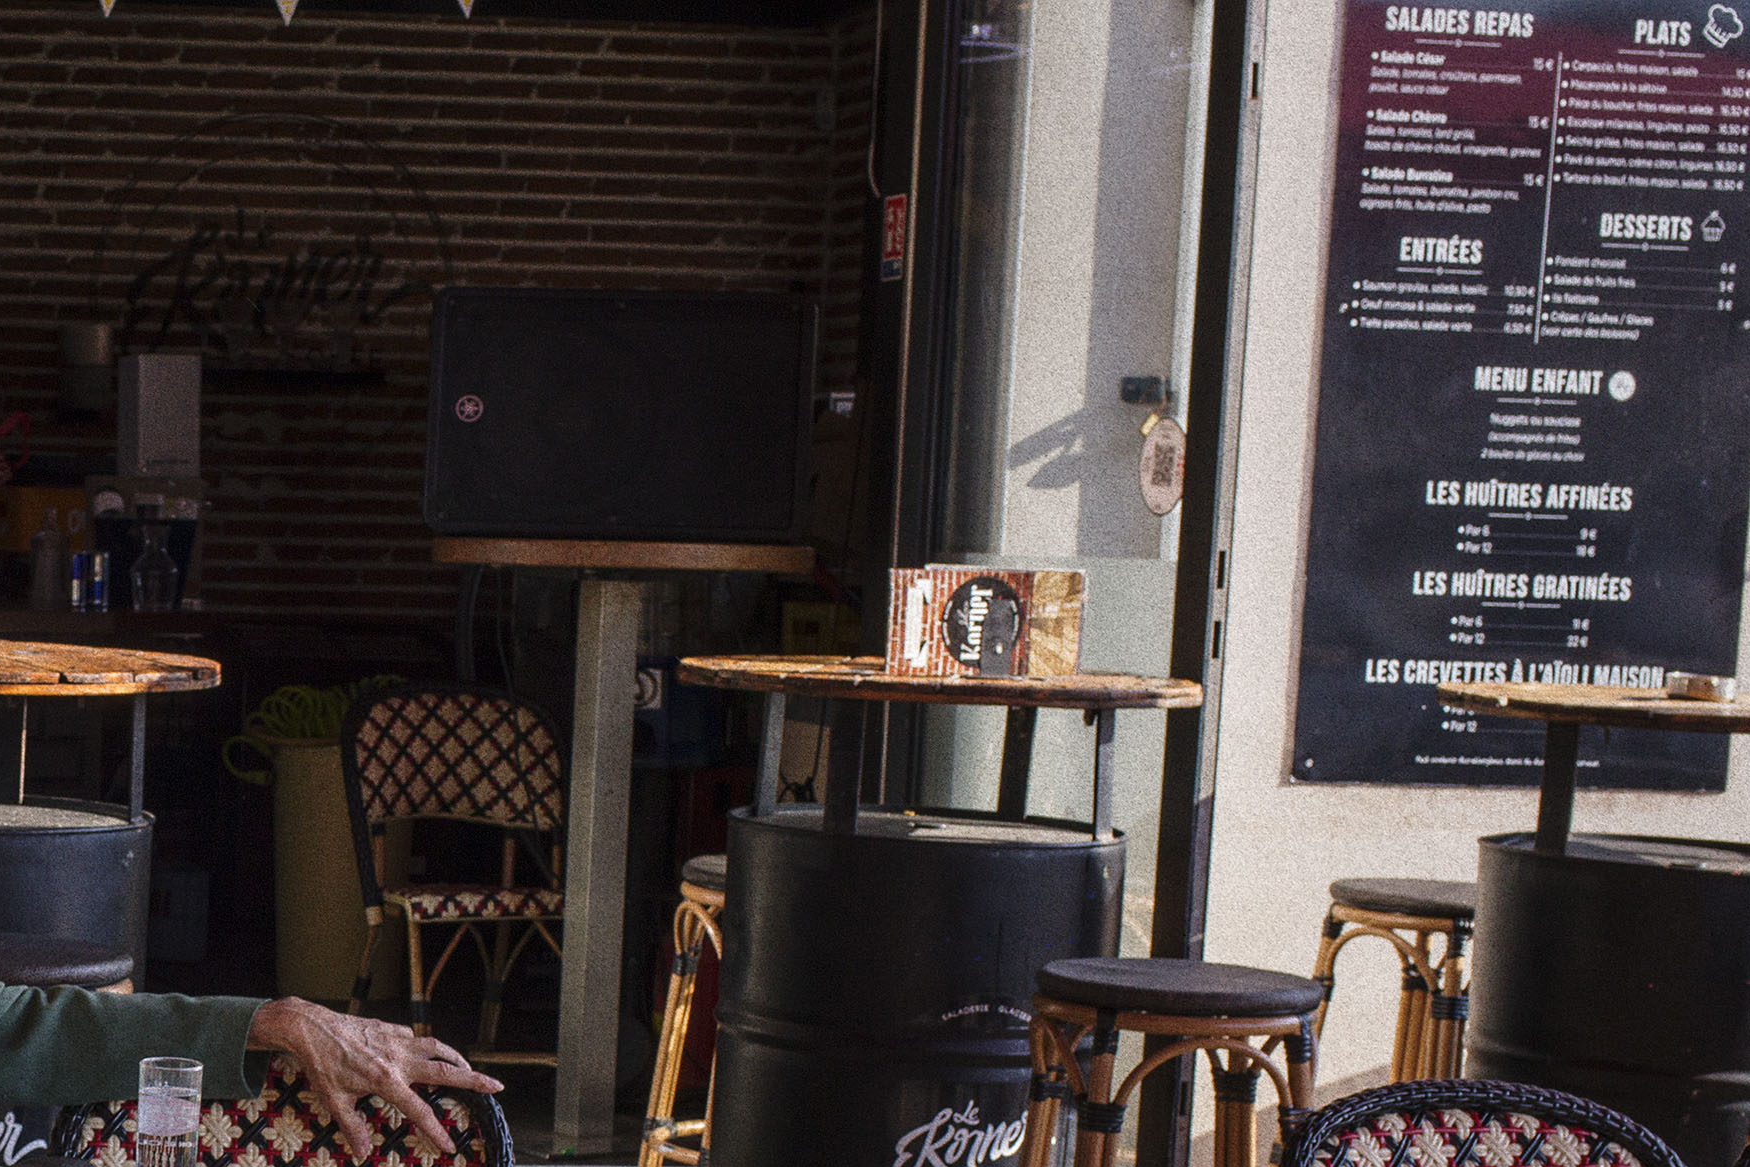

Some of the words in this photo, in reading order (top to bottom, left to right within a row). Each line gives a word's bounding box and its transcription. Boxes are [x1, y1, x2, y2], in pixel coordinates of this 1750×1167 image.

[1385, 6, 1470, 35] SALADES
[1473, 10, 1535, 38] REPAS
[1634, 19, 1692, 47] PLATS
[1380, 50, 1415, 64] Salade
[1375, 108, 1411, 122] Salade
[1371, 165, 1406, 180] Salade
[1599, 211, 1694, 242] DESSERTS
[1399, 234, 1484, 265] ENTRÉES
[1474, 365, 1529, 393] MENU
[1531, 367, 1604, 396] ENFANT
[1425, 480, 1461, 506] LES
[1463, 477, 1543, 509] HUÎTRES
[1545, 482, 1634, 512] AFFINÉES
[1464, 524, 1481, 537] Par
[1463, 541, 1480, 553] Par
[1412, 570, 1447, 596] LES
[1451, 567, 1529, 599] HUÎTRES
[1532, 572, 1632, 602] GRATINÉES
[1458, 615, 1474, 627] Par
[1457, 632, 1474, 645] Par
[1365, 658, 1400, 684] LES
[1403, 659, 1507, 685] CREVETTES
[1593, 664, 1665, 689] MAISON
[952, 1098, 981, 1127] Le
